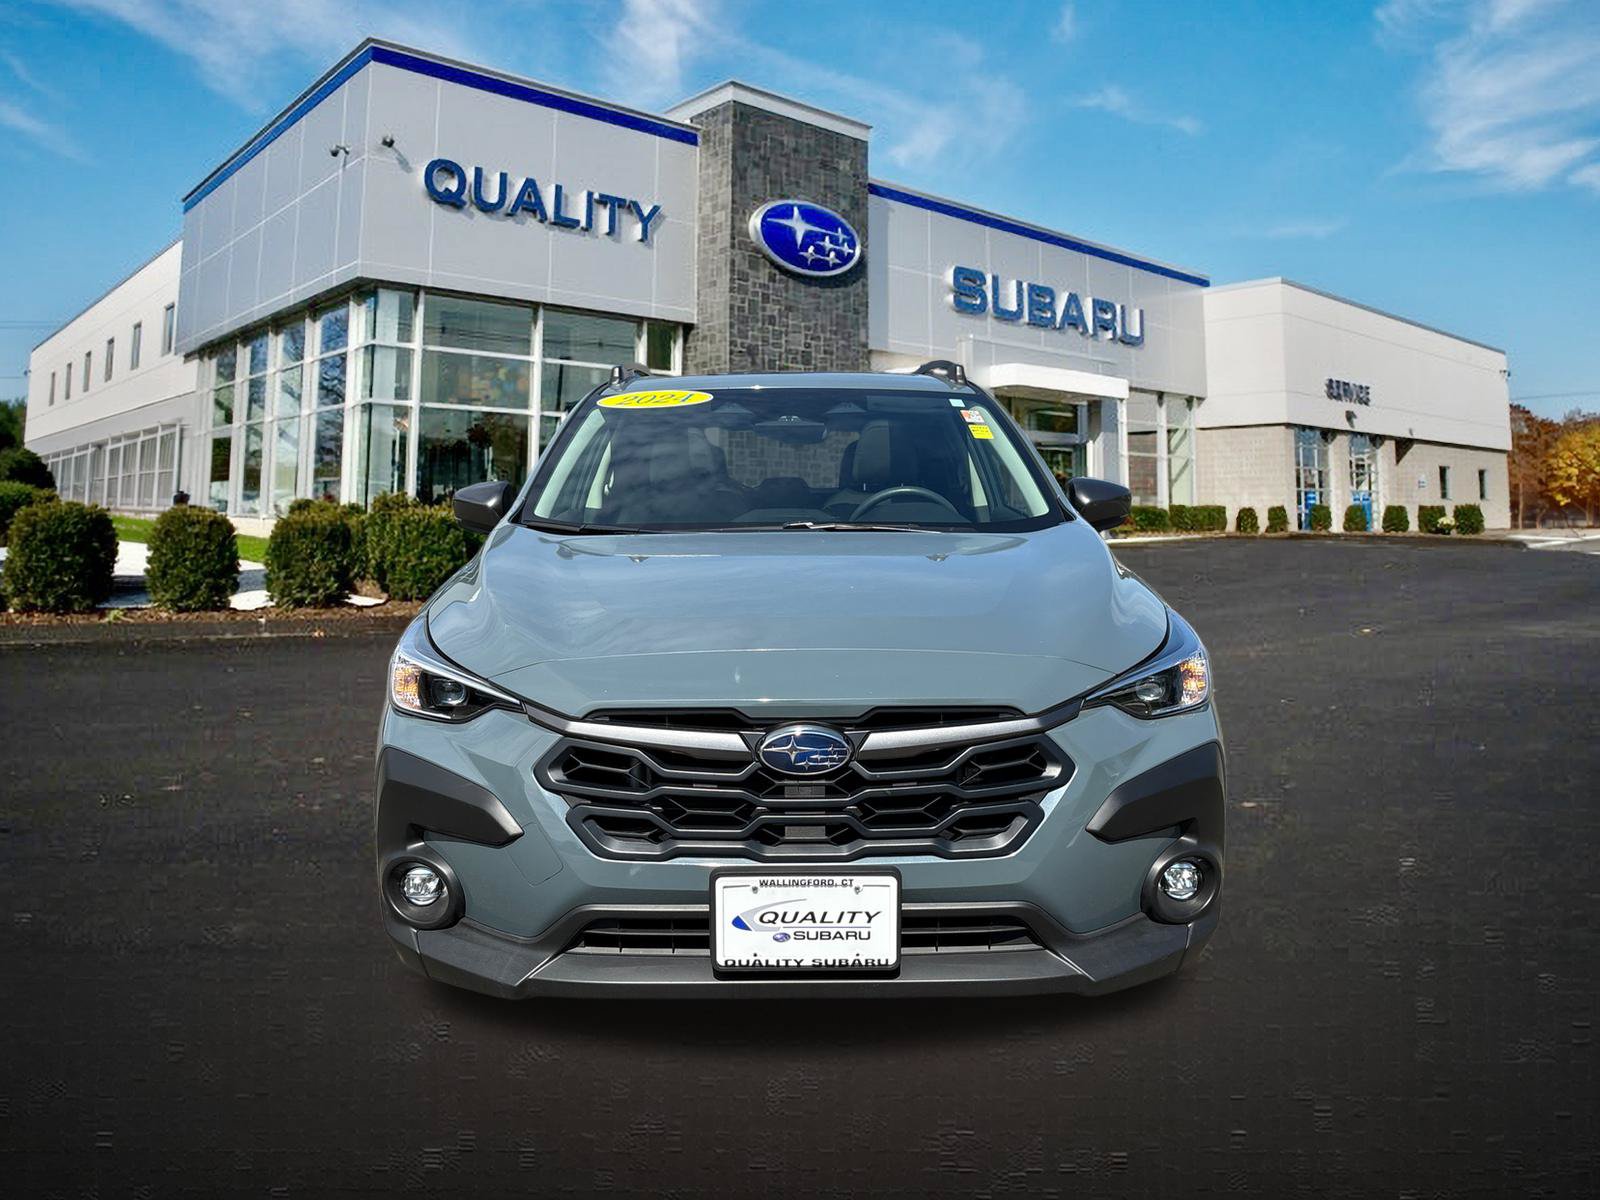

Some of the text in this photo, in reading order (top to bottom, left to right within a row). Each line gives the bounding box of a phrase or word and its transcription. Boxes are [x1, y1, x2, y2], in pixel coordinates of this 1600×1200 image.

[424, 158, 661, 242] QUALITY
[952, 265, 1145, 347] SUBARU
[841, 879, 854, 887] CT
[758, 911, 882, 925] QUALITY
[793, 931, 871, 941] SUBARU
[724, 958, 889, 968] QUALITY SUBARU
